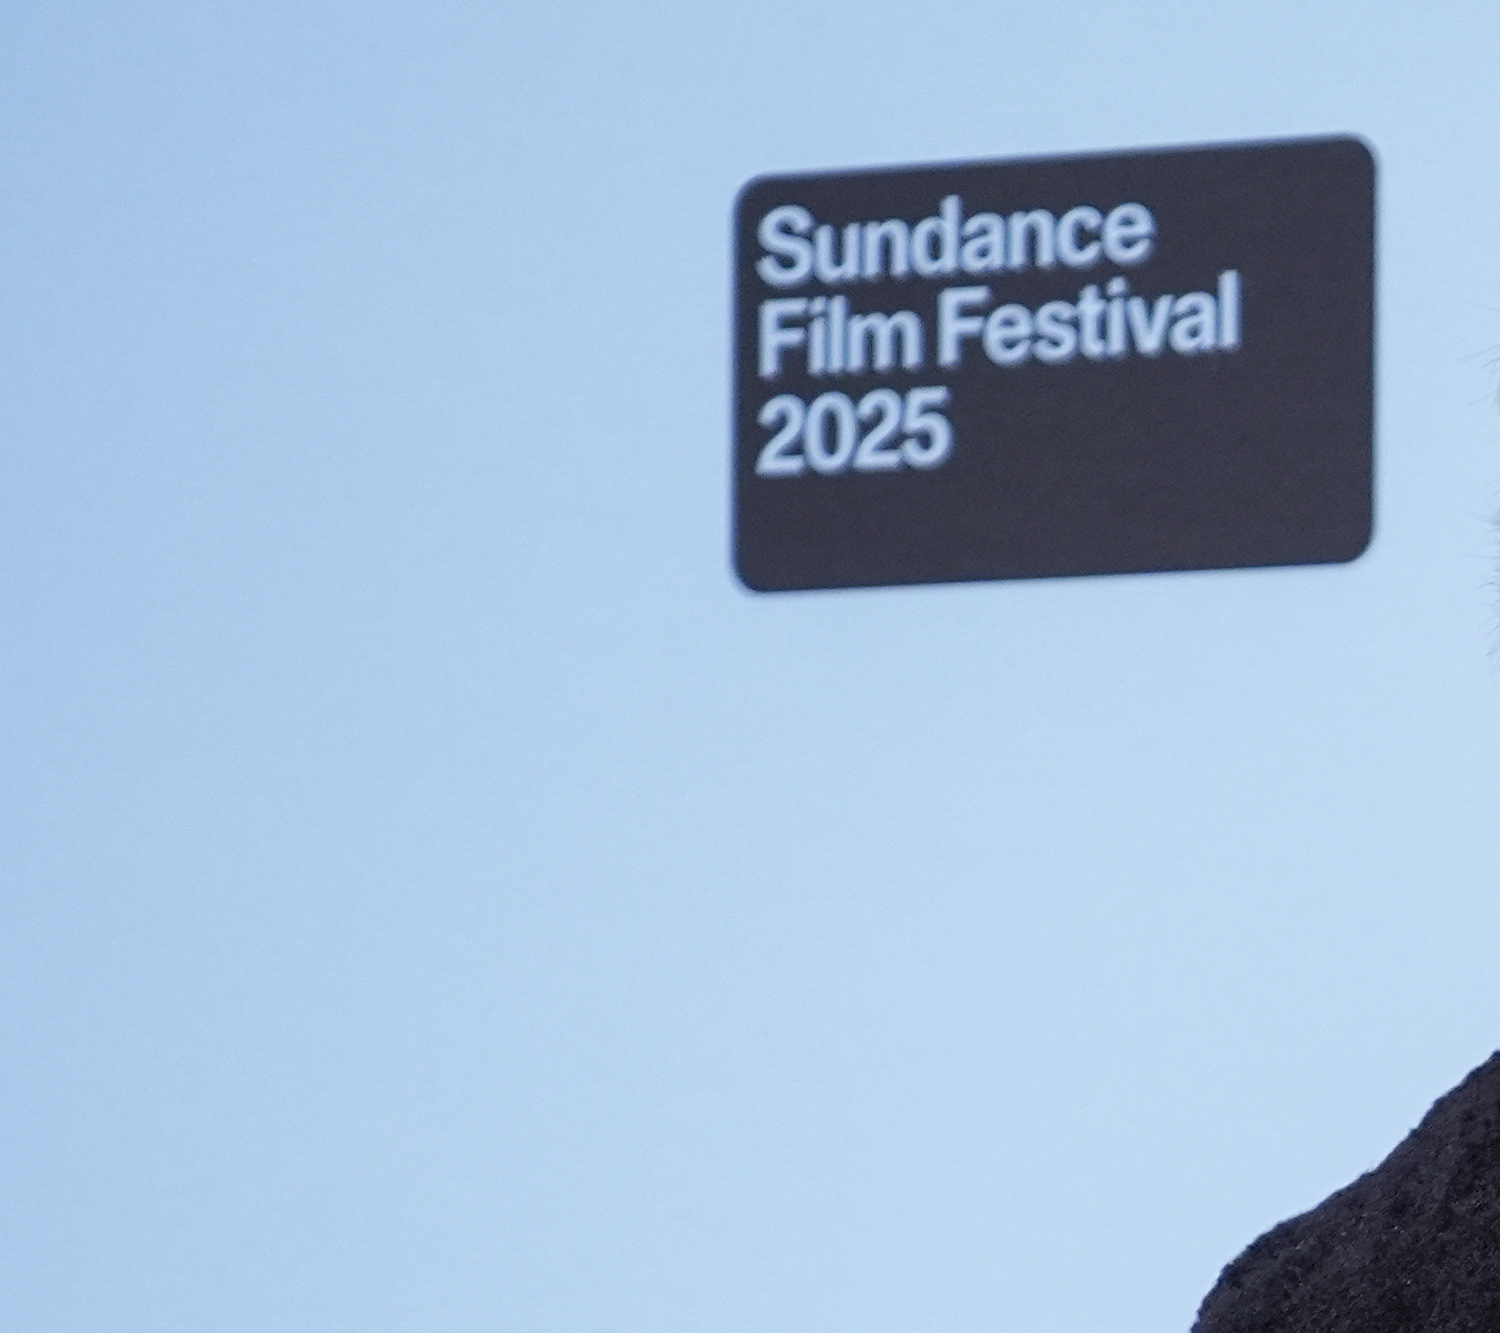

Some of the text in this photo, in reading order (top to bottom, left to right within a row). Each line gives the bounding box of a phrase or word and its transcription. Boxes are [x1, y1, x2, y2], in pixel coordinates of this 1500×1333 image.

[757, 195, 1155, 287] Sundance
[758, 270, 1240, 378] Film Festival
[756, 386, 952, 476] 2025
